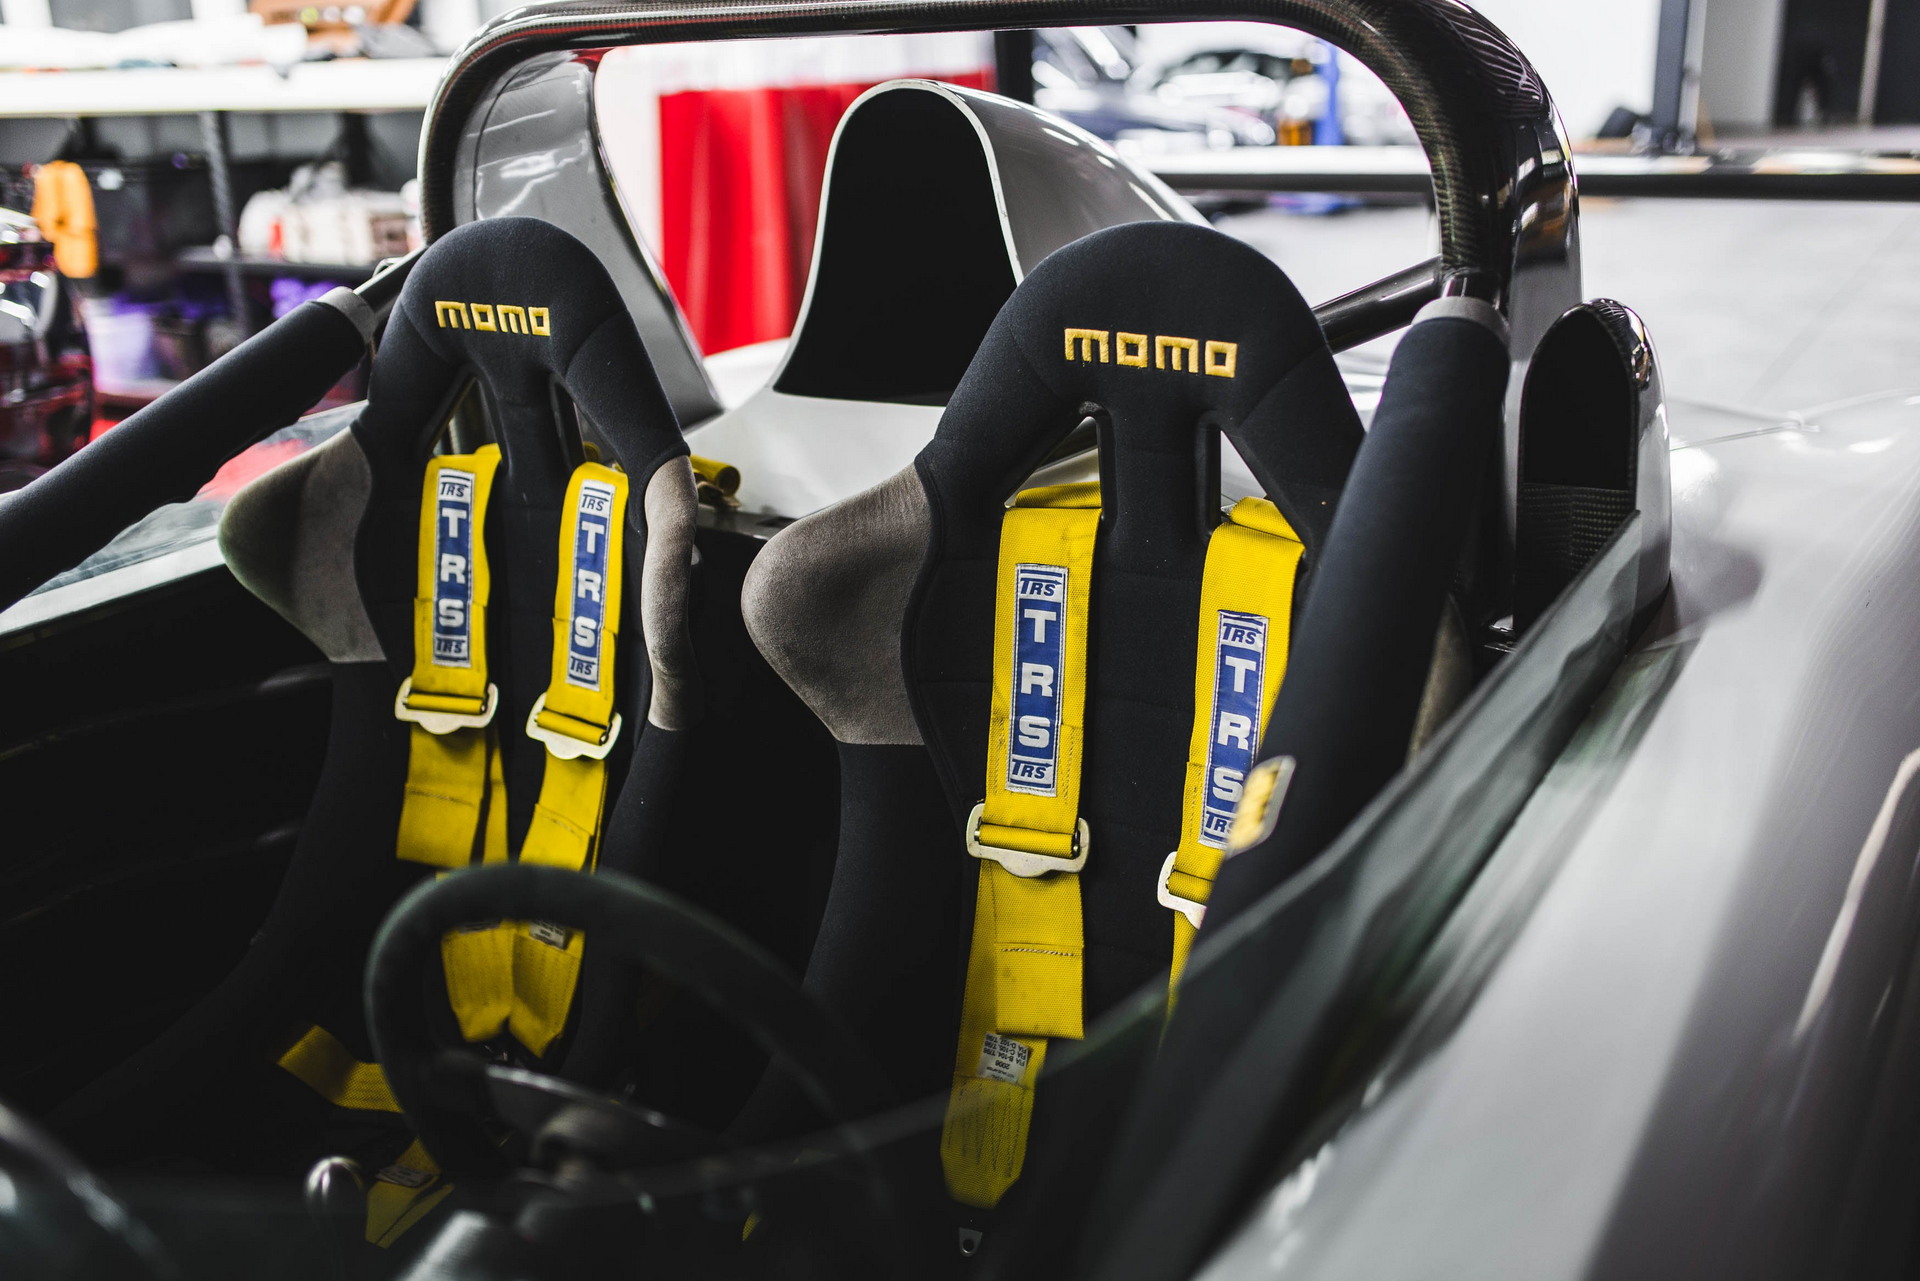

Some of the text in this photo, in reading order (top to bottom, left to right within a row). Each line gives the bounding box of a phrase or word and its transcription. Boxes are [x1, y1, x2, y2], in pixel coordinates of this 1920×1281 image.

[440, 482, 469, 498] TRS
[581, 494, 609, 511] TRS
[438, 508, 467, 627] TRS
[574, 520, 605, 649] TRS
[1020, 578, 1062, 597] TRS
[1222, 622, 1262, 645] TRS
[435, 638, 466, 654] TRS
[570, 659, 596, 676] TRS
[1018, 609, 1057, 749] TRS
[1212, 656, 1257, 803] TRS
[1012, 759, 1052, 780] TRS
